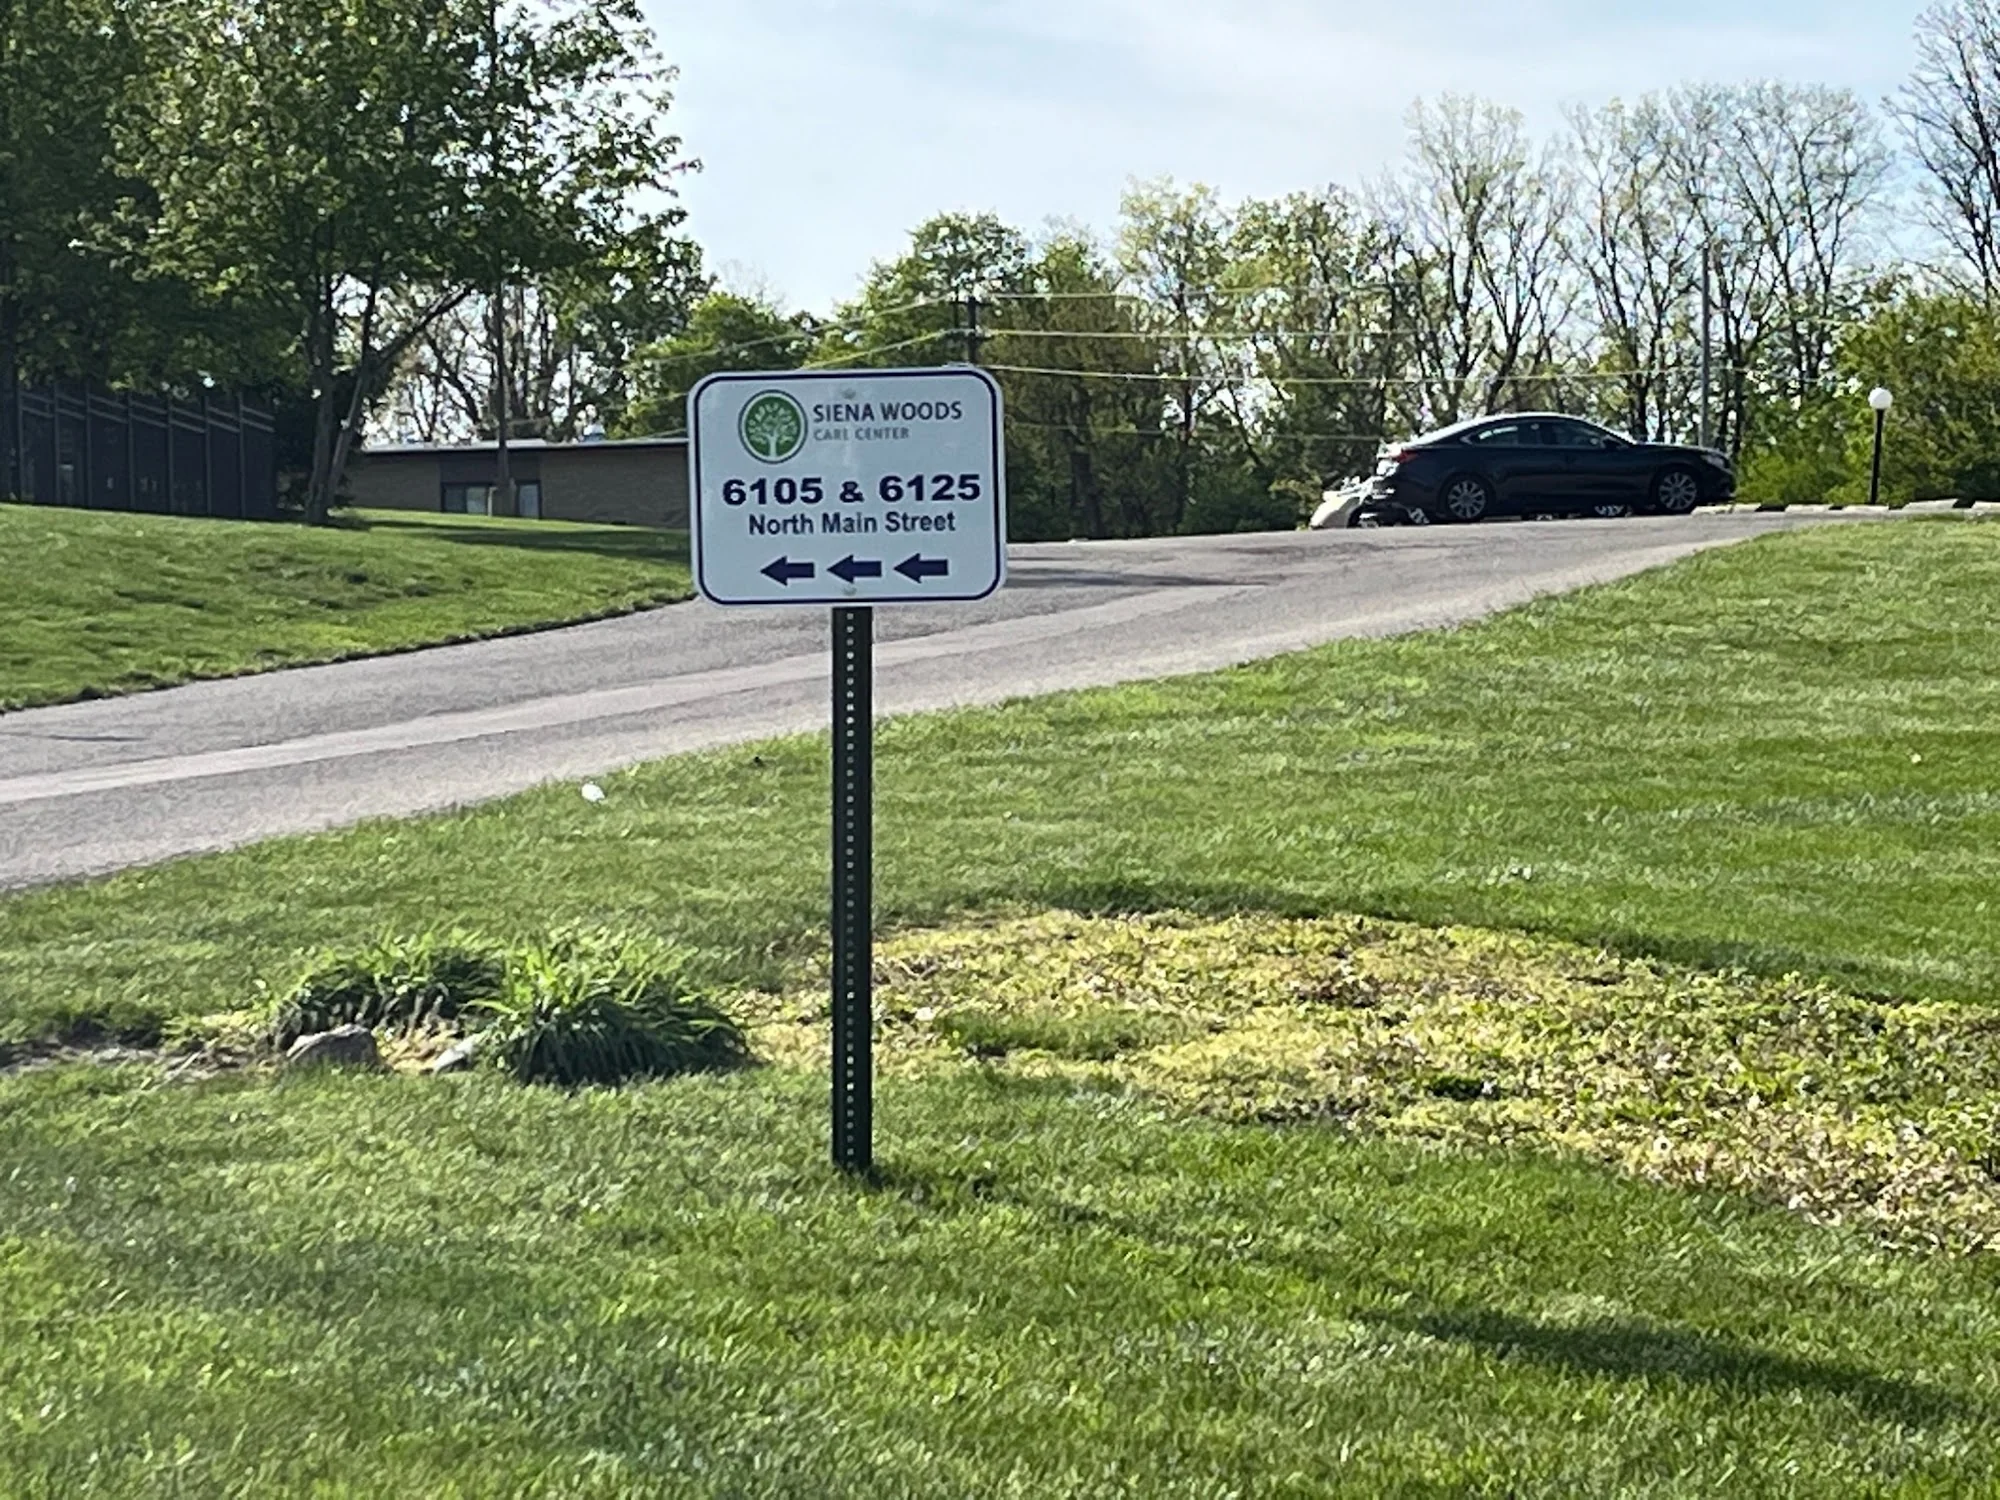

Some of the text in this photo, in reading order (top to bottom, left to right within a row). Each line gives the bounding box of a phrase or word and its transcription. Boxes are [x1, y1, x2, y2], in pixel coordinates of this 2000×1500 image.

[813, 401, 963, 423] SIENA WOODS
[813, 427, 910, 442] CARE CENTER
[722, 474, 981, 506] 6105 & 6125
[748, 511, 956, 536] North Main Street
